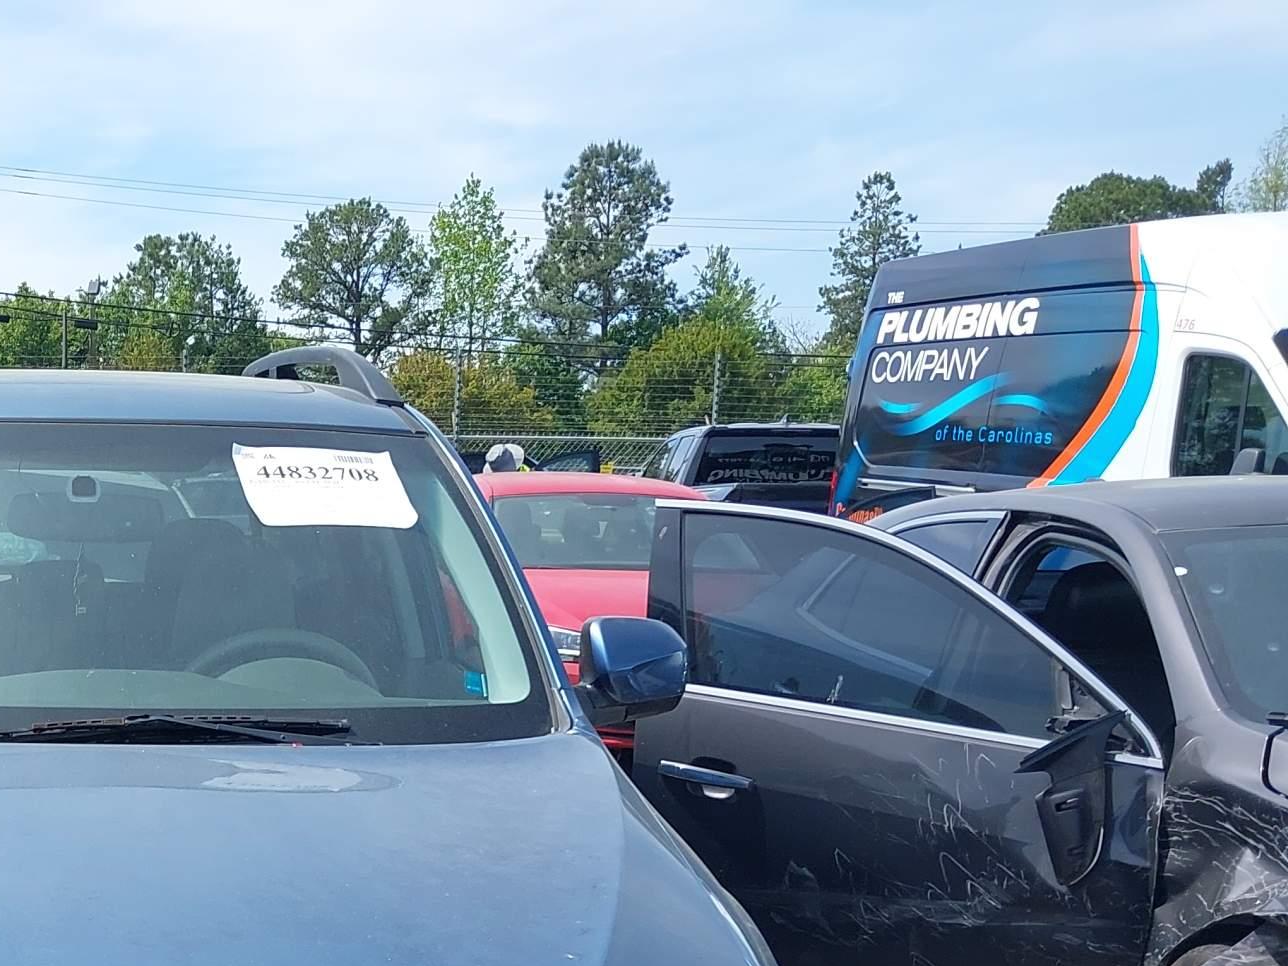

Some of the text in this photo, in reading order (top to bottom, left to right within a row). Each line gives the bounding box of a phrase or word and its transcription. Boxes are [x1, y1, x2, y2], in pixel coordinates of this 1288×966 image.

[888, 291, 905, 304] THE
[876, 298, 1040, 344] PLUMBING
[871, 346, 989, 383] COMPANY
[935, 424, 1053, 445] of the Carolinas
[256, 465, 379, 482] 44832708
